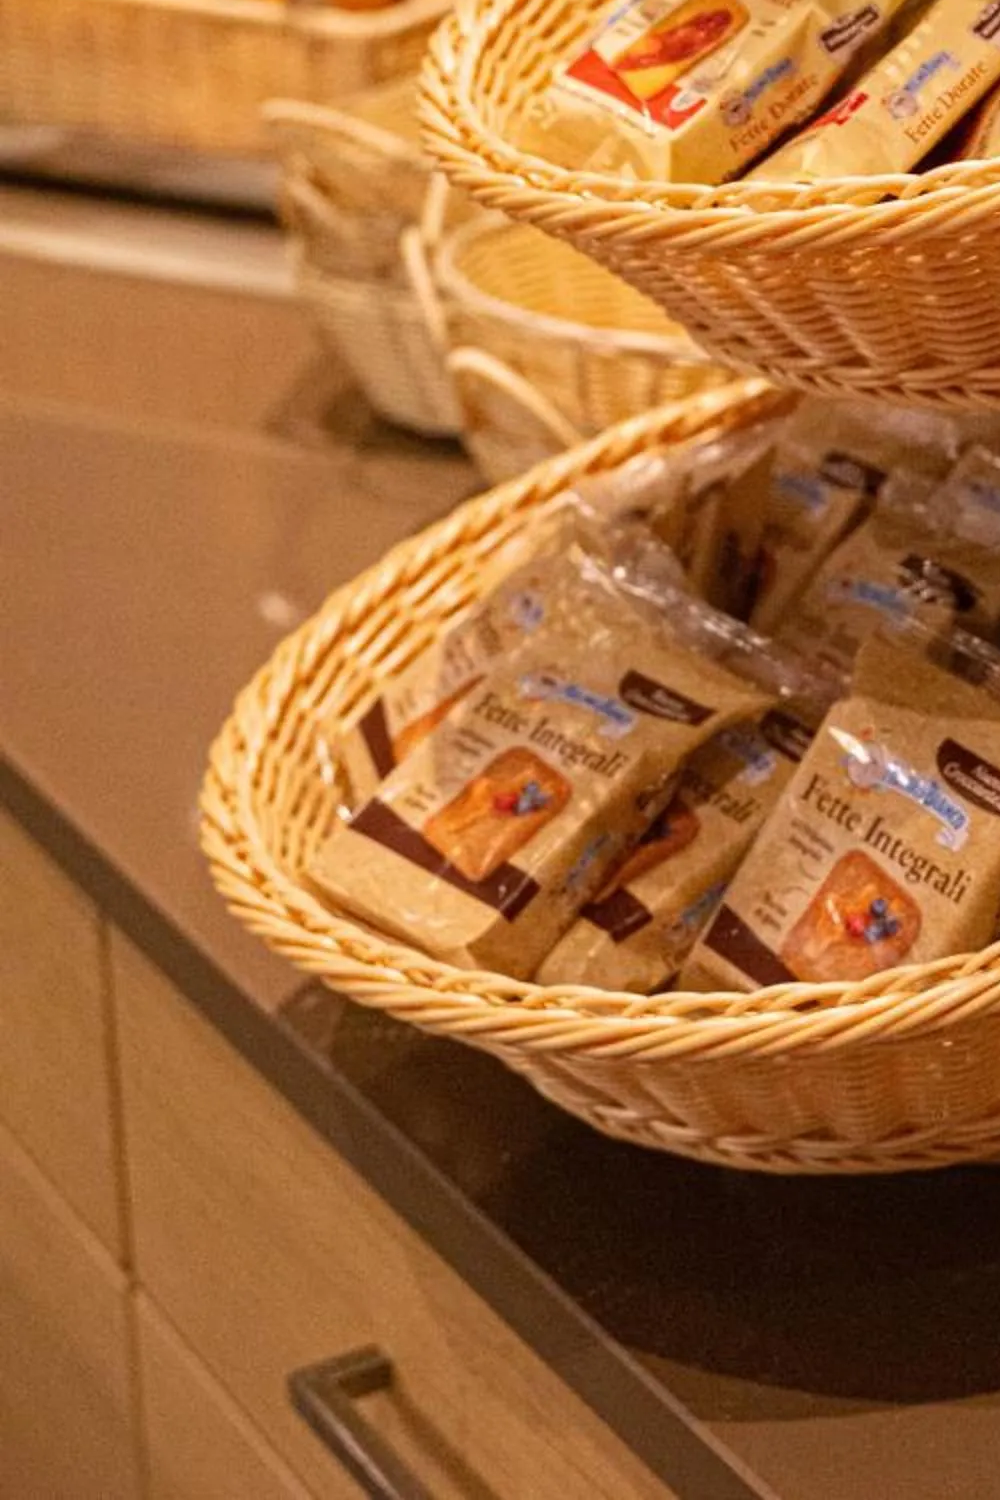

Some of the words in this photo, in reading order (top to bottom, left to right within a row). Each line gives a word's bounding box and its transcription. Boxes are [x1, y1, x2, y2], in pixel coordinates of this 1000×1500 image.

[904, 104, 944, 146] Fette
[529, 716, 627, 778] Integrali
[802, 773, 863, 831] Fette
[865, 815, 972, 904] Integrali
